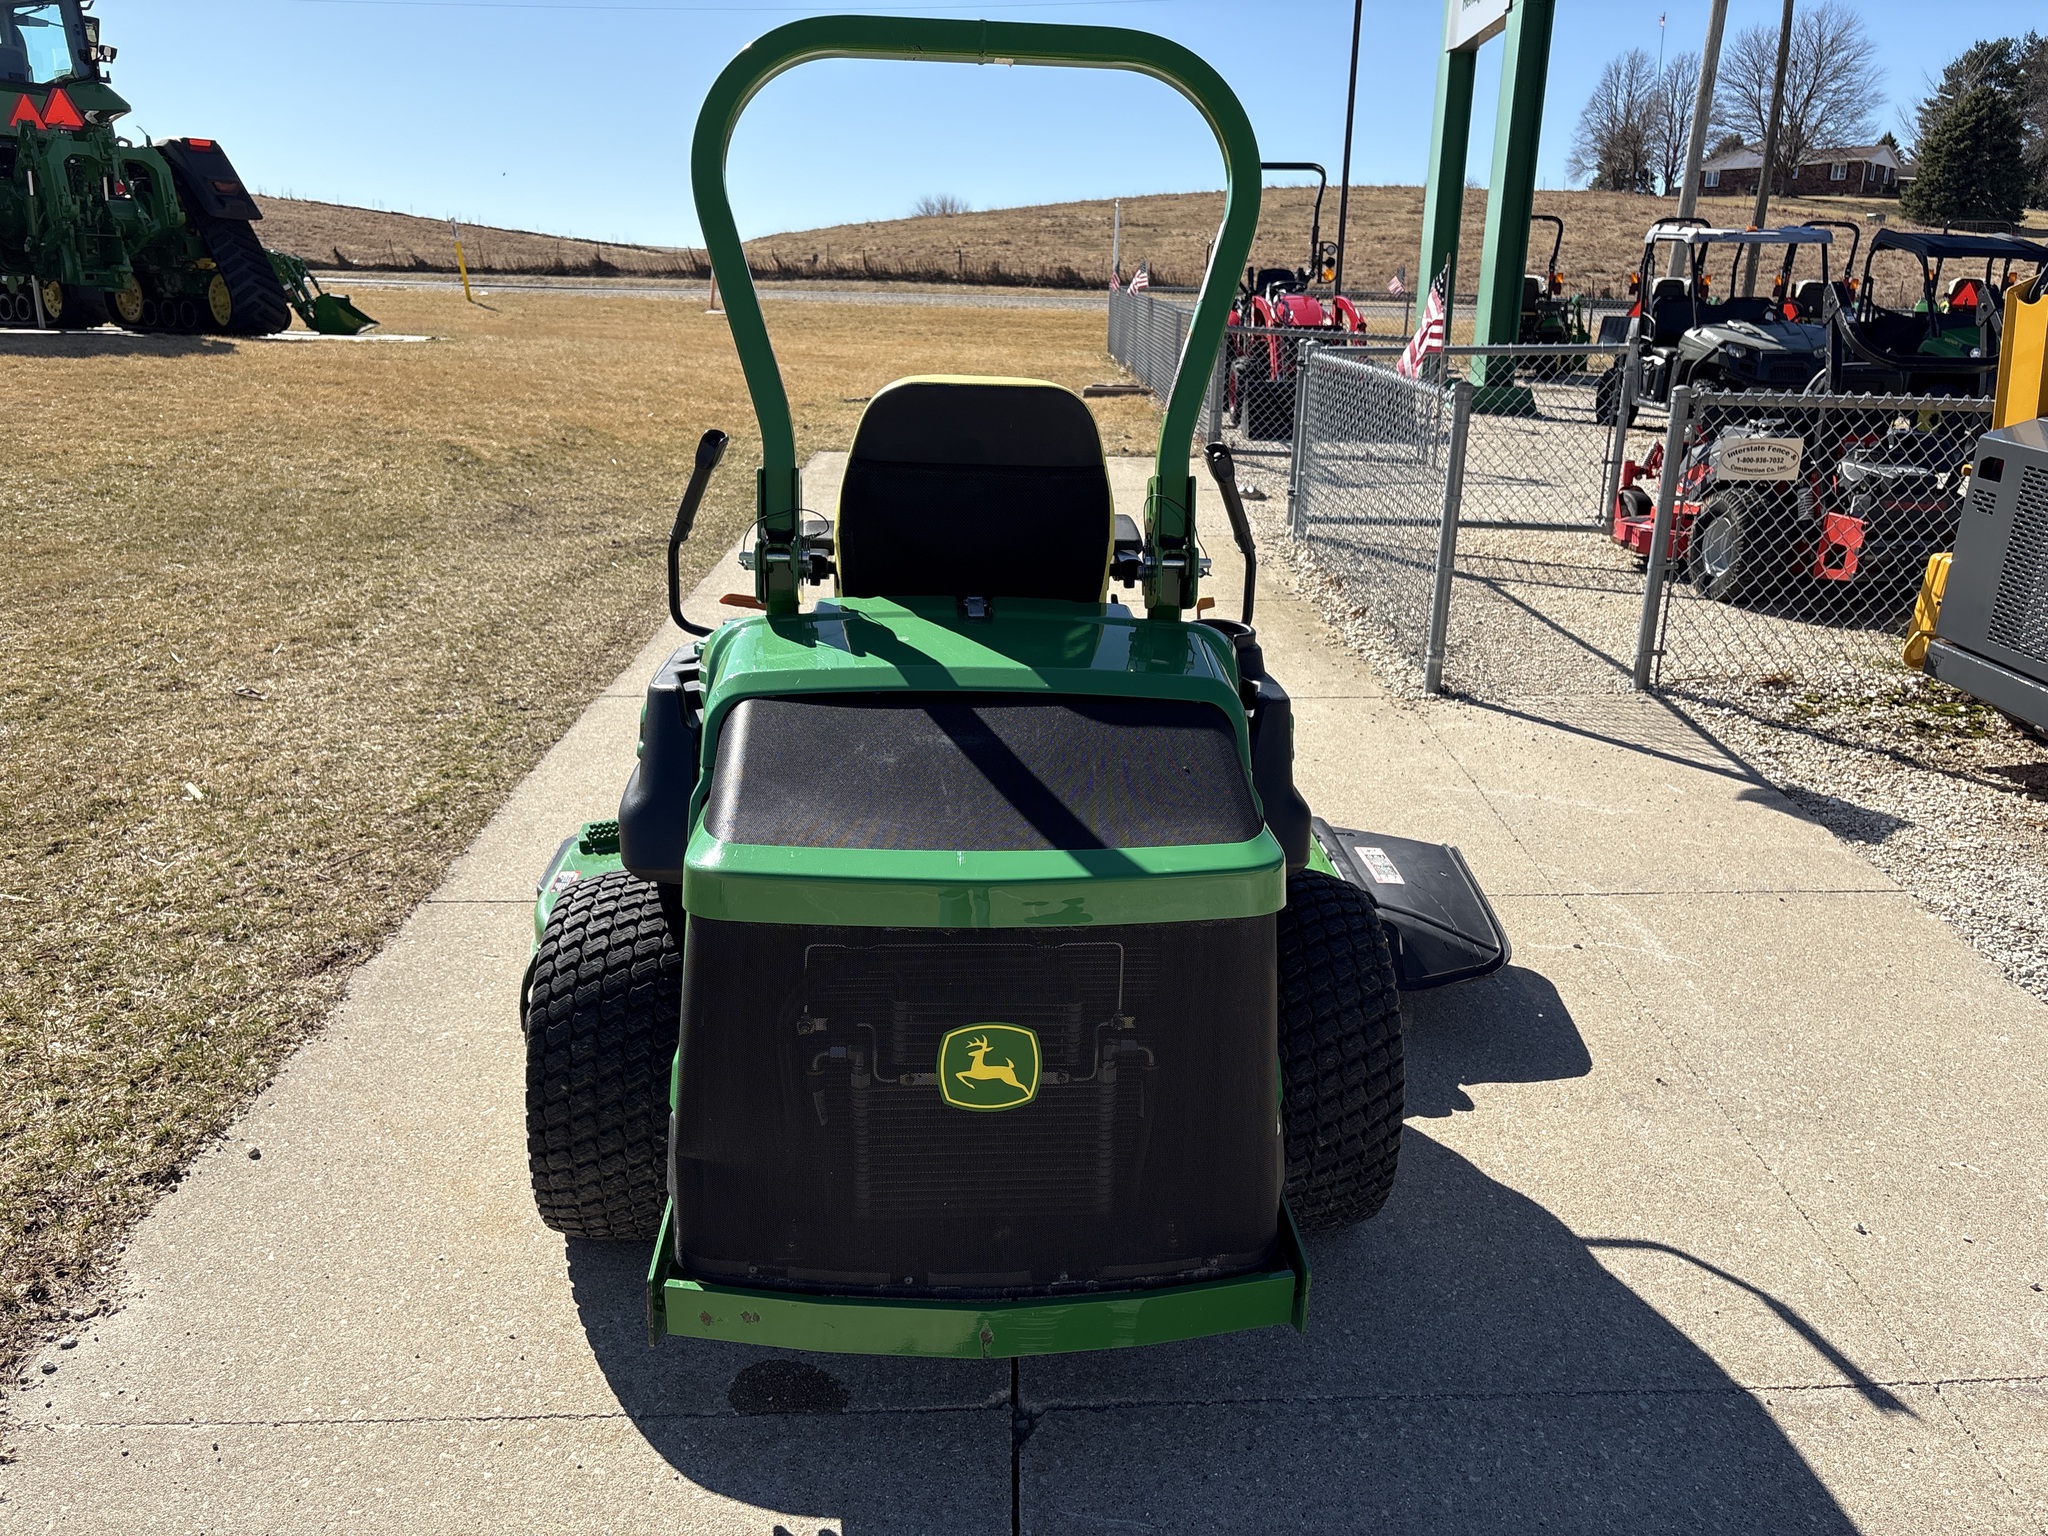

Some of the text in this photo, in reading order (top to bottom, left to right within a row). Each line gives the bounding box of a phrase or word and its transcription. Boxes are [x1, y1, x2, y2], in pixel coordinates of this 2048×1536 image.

[1727, 445, 1766, 459] Interstate
[1767, 445, 1790, 456] Fence
[1736, 456, 1785, 464] 1-800-936-7032
[1730, 464, 1766, 473] Construction
